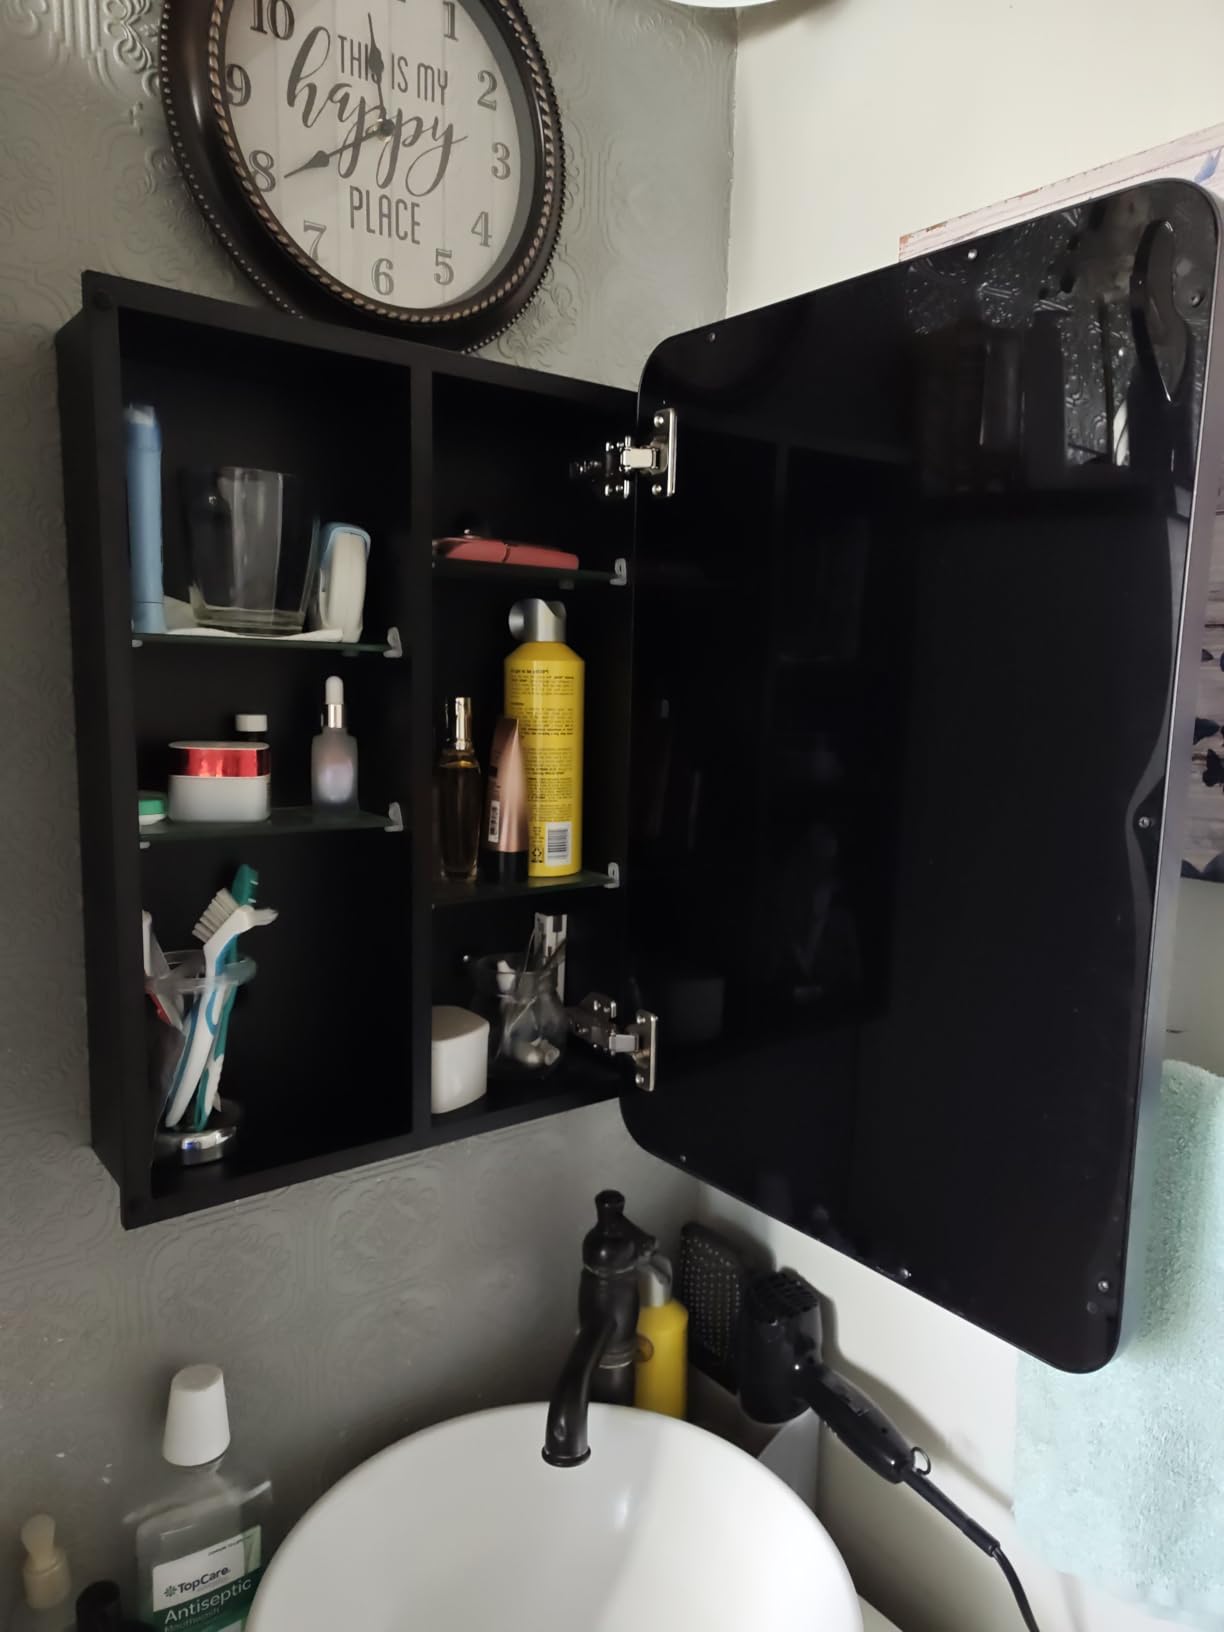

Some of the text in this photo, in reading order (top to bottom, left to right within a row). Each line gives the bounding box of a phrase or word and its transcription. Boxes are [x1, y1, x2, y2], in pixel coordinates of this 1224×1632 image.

[249, 0, 295, 40] 10
[442, 0, 459, 41] 1
[225, 63, 252, 107] 9
[391, 53, 409, 94] IS
[477, 70, 498, 111] 2
[286, 25, 468, 197] happy
[248, 149, 276, 193] 8
[491, 142, 511, 180] 3
[348, 185, 421, 245] PLACE
[470, 211, 492, 248] 4
[302, 219, 327, 261] 7
[371, 257, 394, 296] 6
[433, 248, 454, 285] 5
[177, 1566, 230, 1594] TopCare
[164, 1578, 252, 1625] Antiseptic
